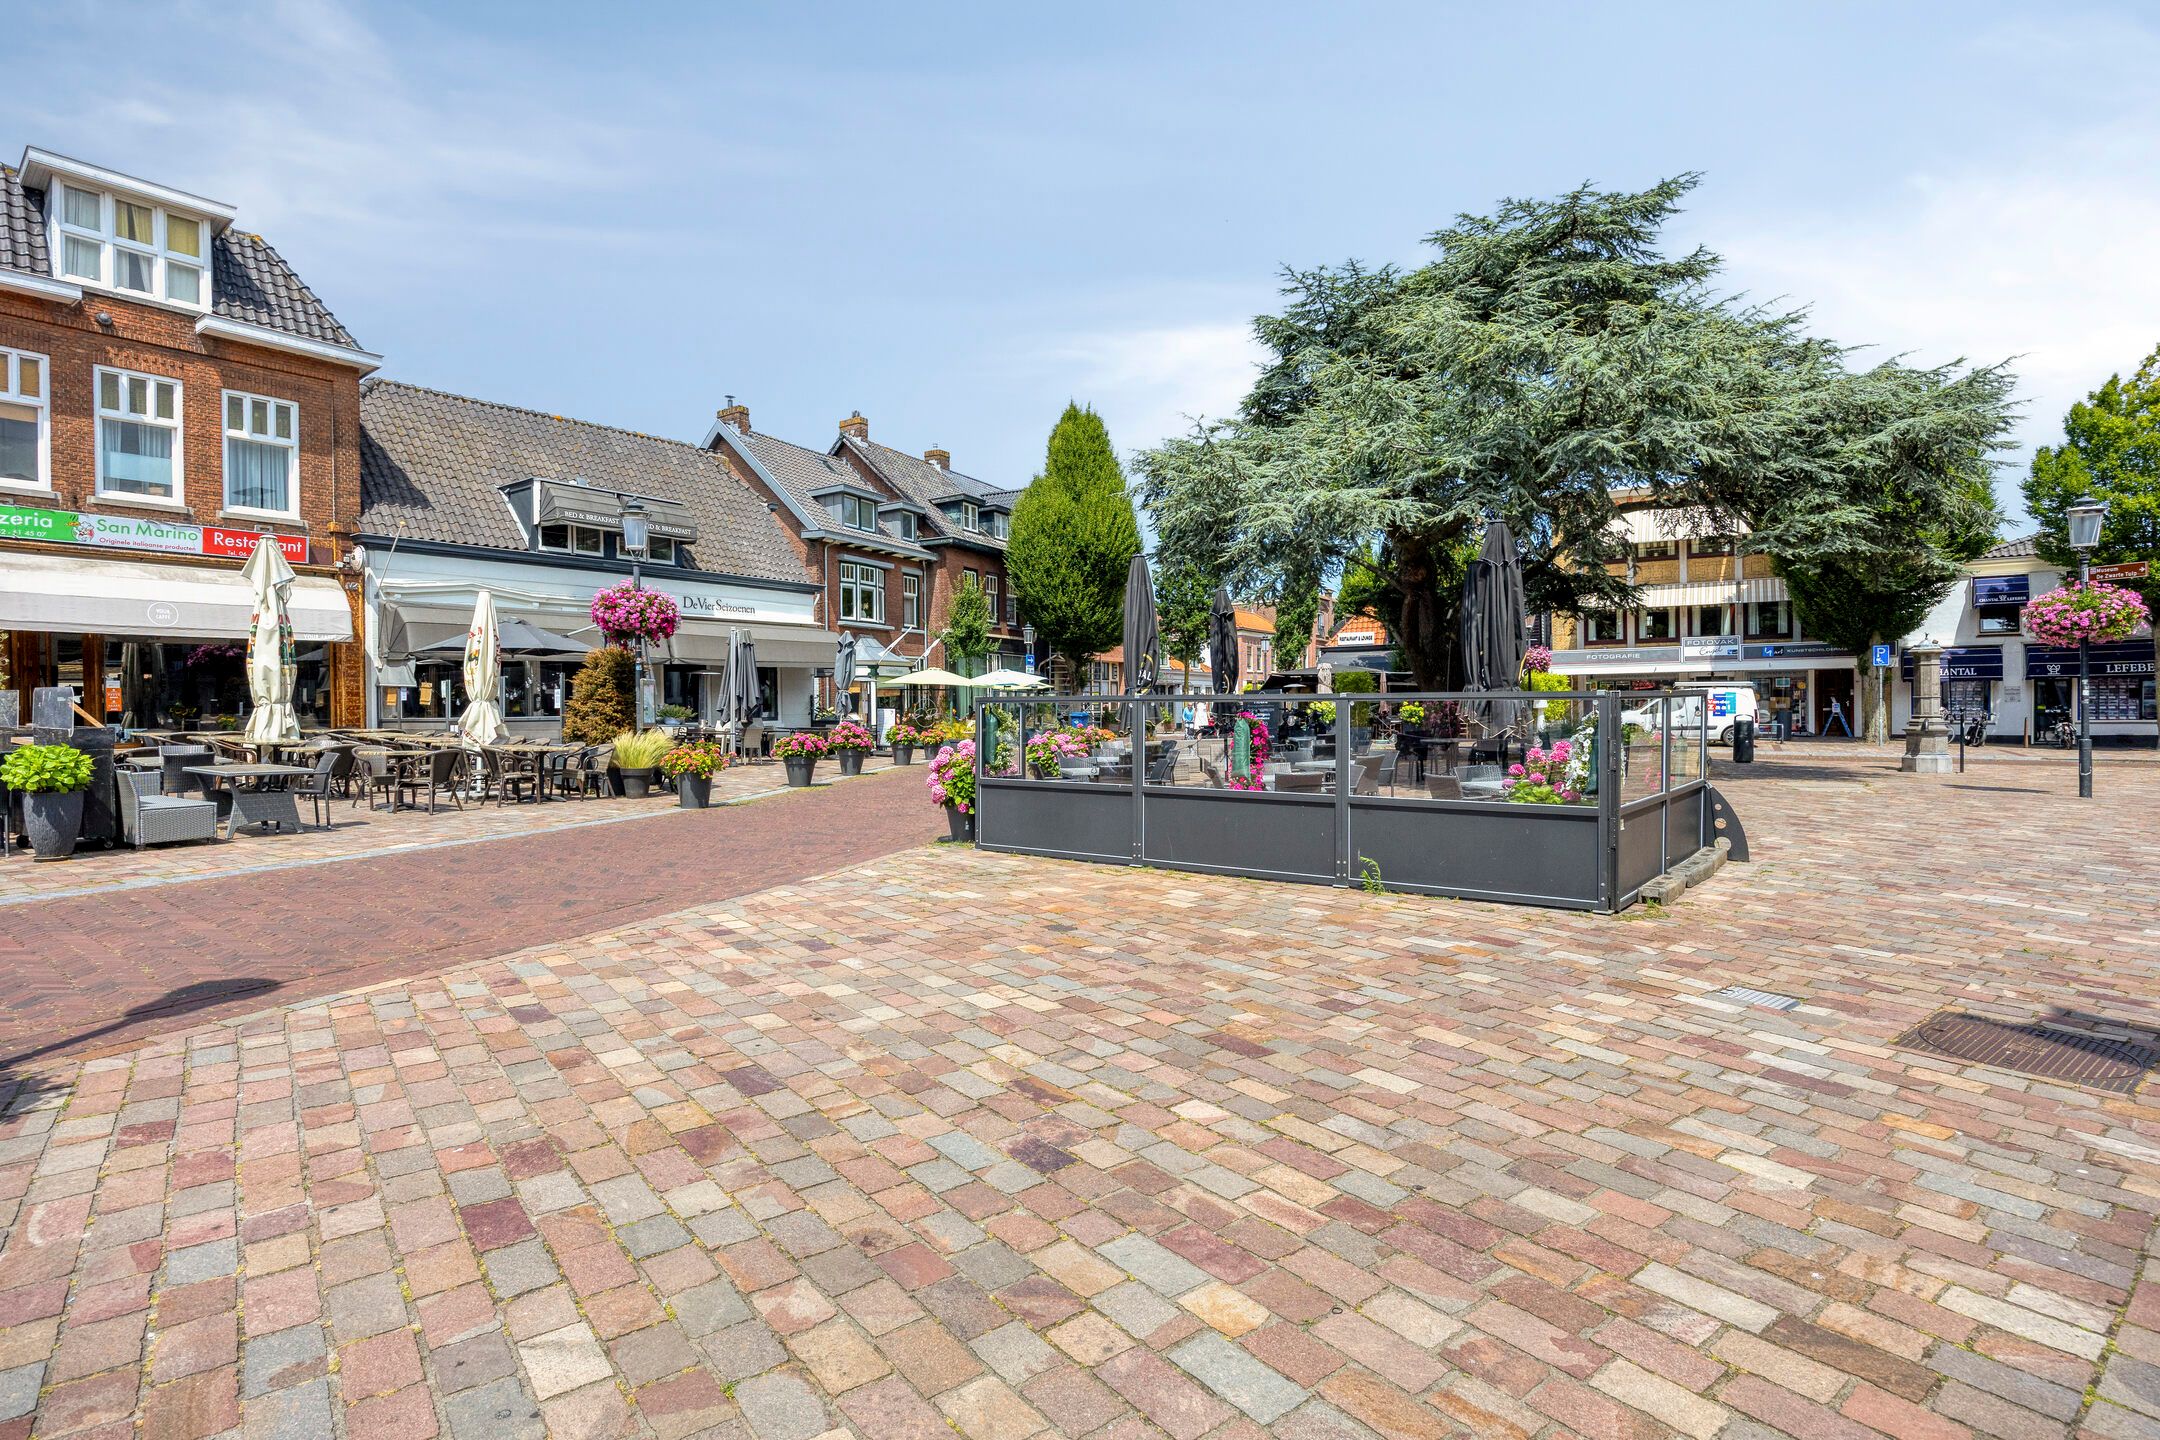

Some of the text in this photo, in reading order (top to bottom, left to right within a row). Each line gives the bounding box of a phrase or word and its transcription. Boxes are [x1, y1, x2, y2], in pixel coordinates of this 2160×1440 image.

[586, 514, 619, 524] BREAKFAST
[97, 519, 198, 541] San Marino
[662, 526, 691, 535] BREAKFAST
[100, 537, 130, 546] Originele
[214, 532, 302, 552] Restaant
[683, 596, 755, 614] De Vier Seizoenen
[1687, 638, 1735, 646] FOTOVAK
[1877, 648, 1886, 658] P
[2106, 663, 2155, 673] LEFEBE
